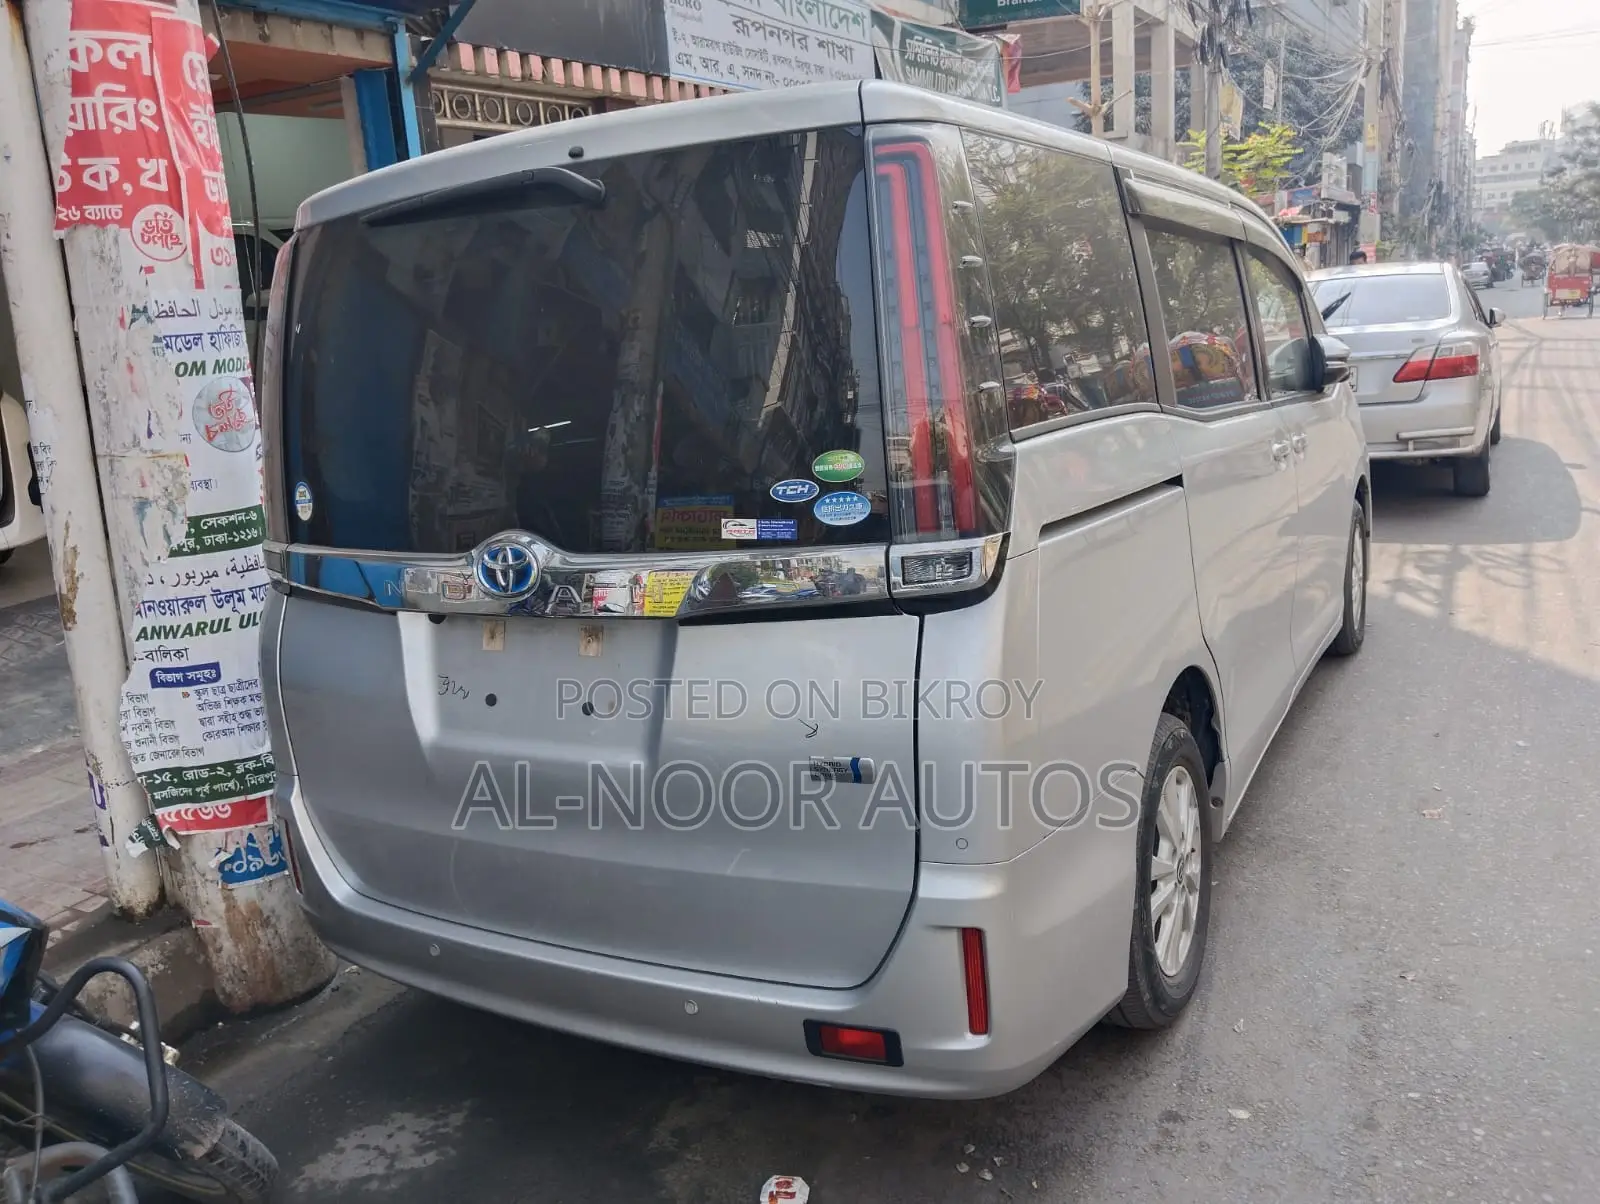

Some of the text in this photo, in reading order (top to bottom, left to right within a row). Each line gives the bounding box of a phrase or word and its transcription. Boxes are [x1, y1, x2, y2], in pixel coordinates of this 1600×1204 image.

[729, 13, 855, 64] রূপনগর শাখা
[82, 204, 123, 220] ব্যাচে
[163, 332, 205, 353] মডেল
[174, 360, 206, 378] OM
[776, 484, 809, 496] TCH
[225, 554, 265, 579] افظية،
[210, 580, 247, 615] উলূম
[135, 617, 232, 642] ANWARUL
[155, 670, 184, 684] বিভাগ
